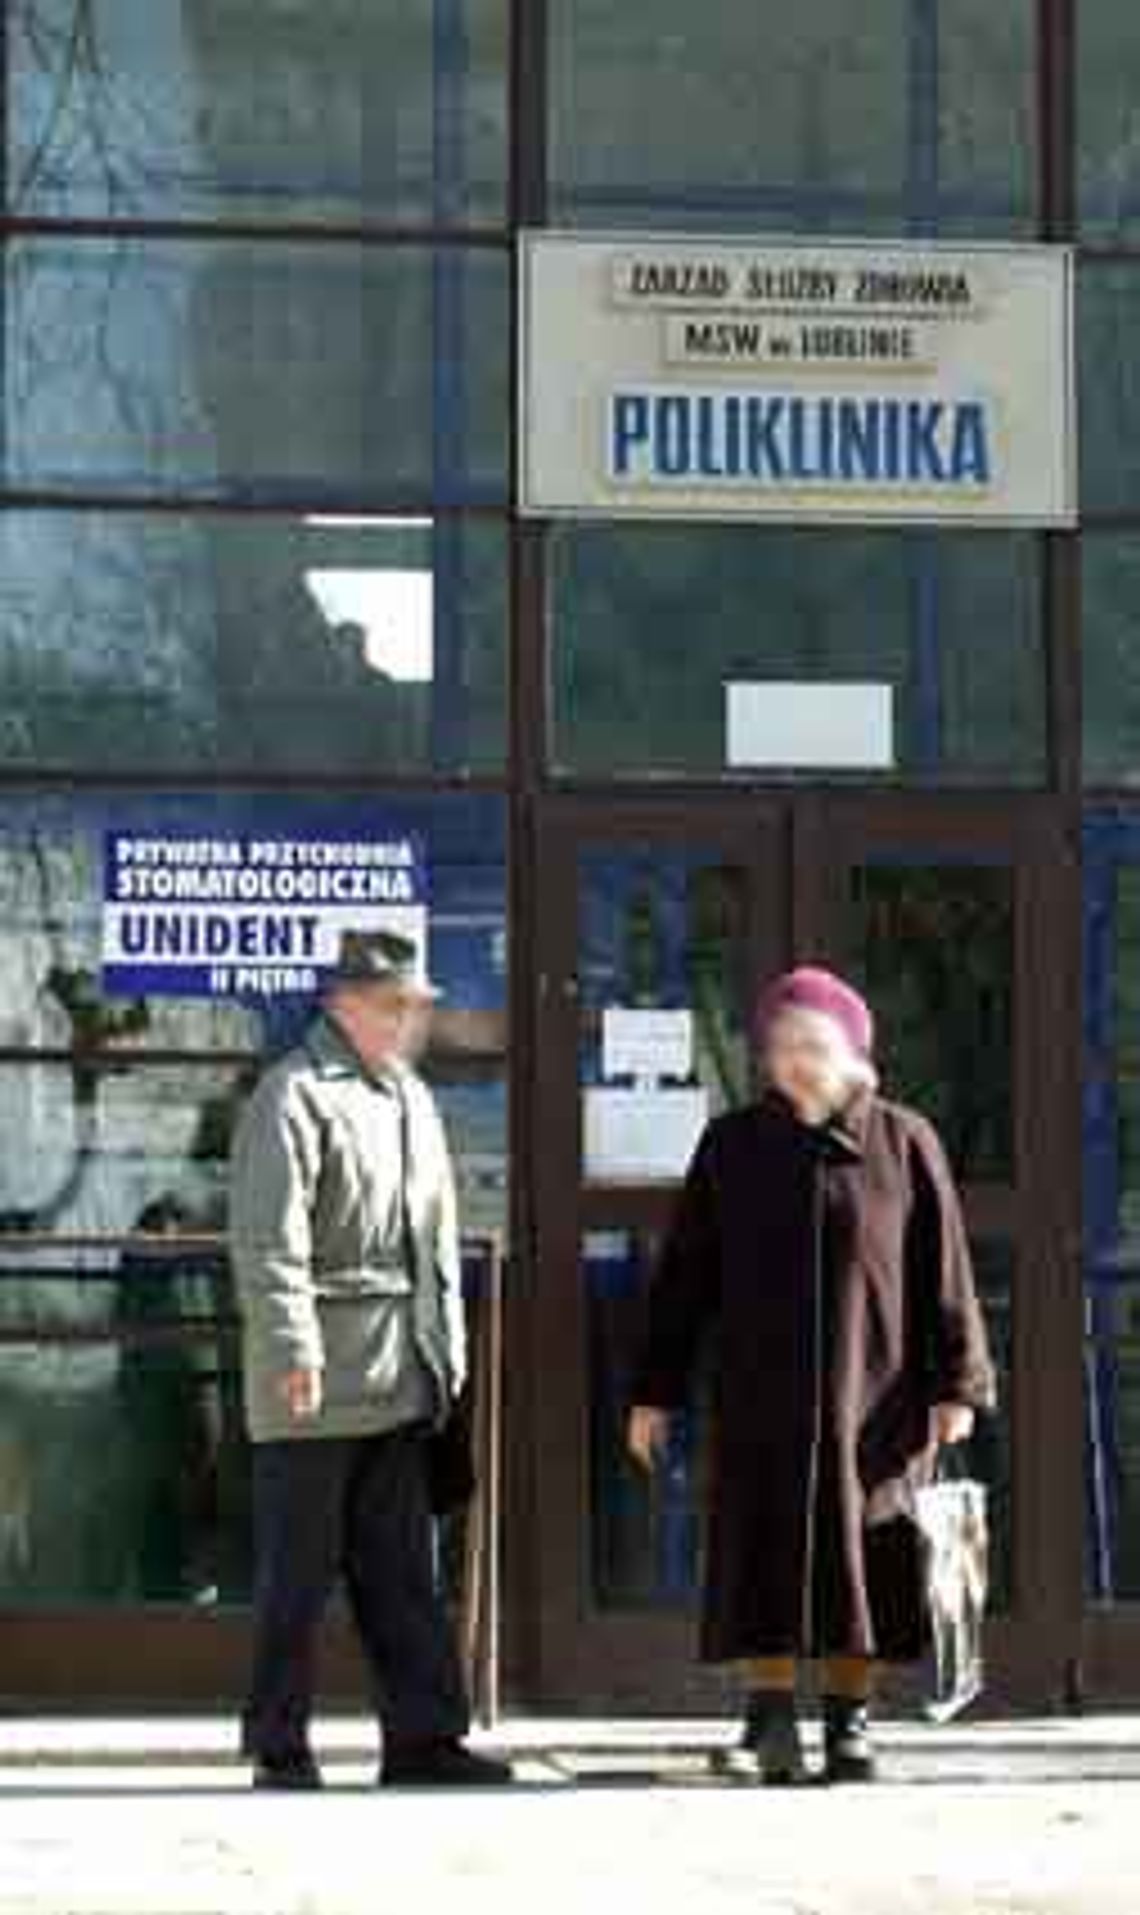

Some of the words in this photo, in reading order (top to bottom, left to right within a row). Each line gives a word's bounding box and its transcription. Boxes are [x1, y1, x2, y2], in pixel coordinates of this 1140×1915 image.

[685, 322, 759, 353] MSW
[612, 395, 990, 483] POLIKLINIKA
[116, 868, 413, 898] STOMATOLOGICZNA
[120, 914, 319, 956] UNIDENT
